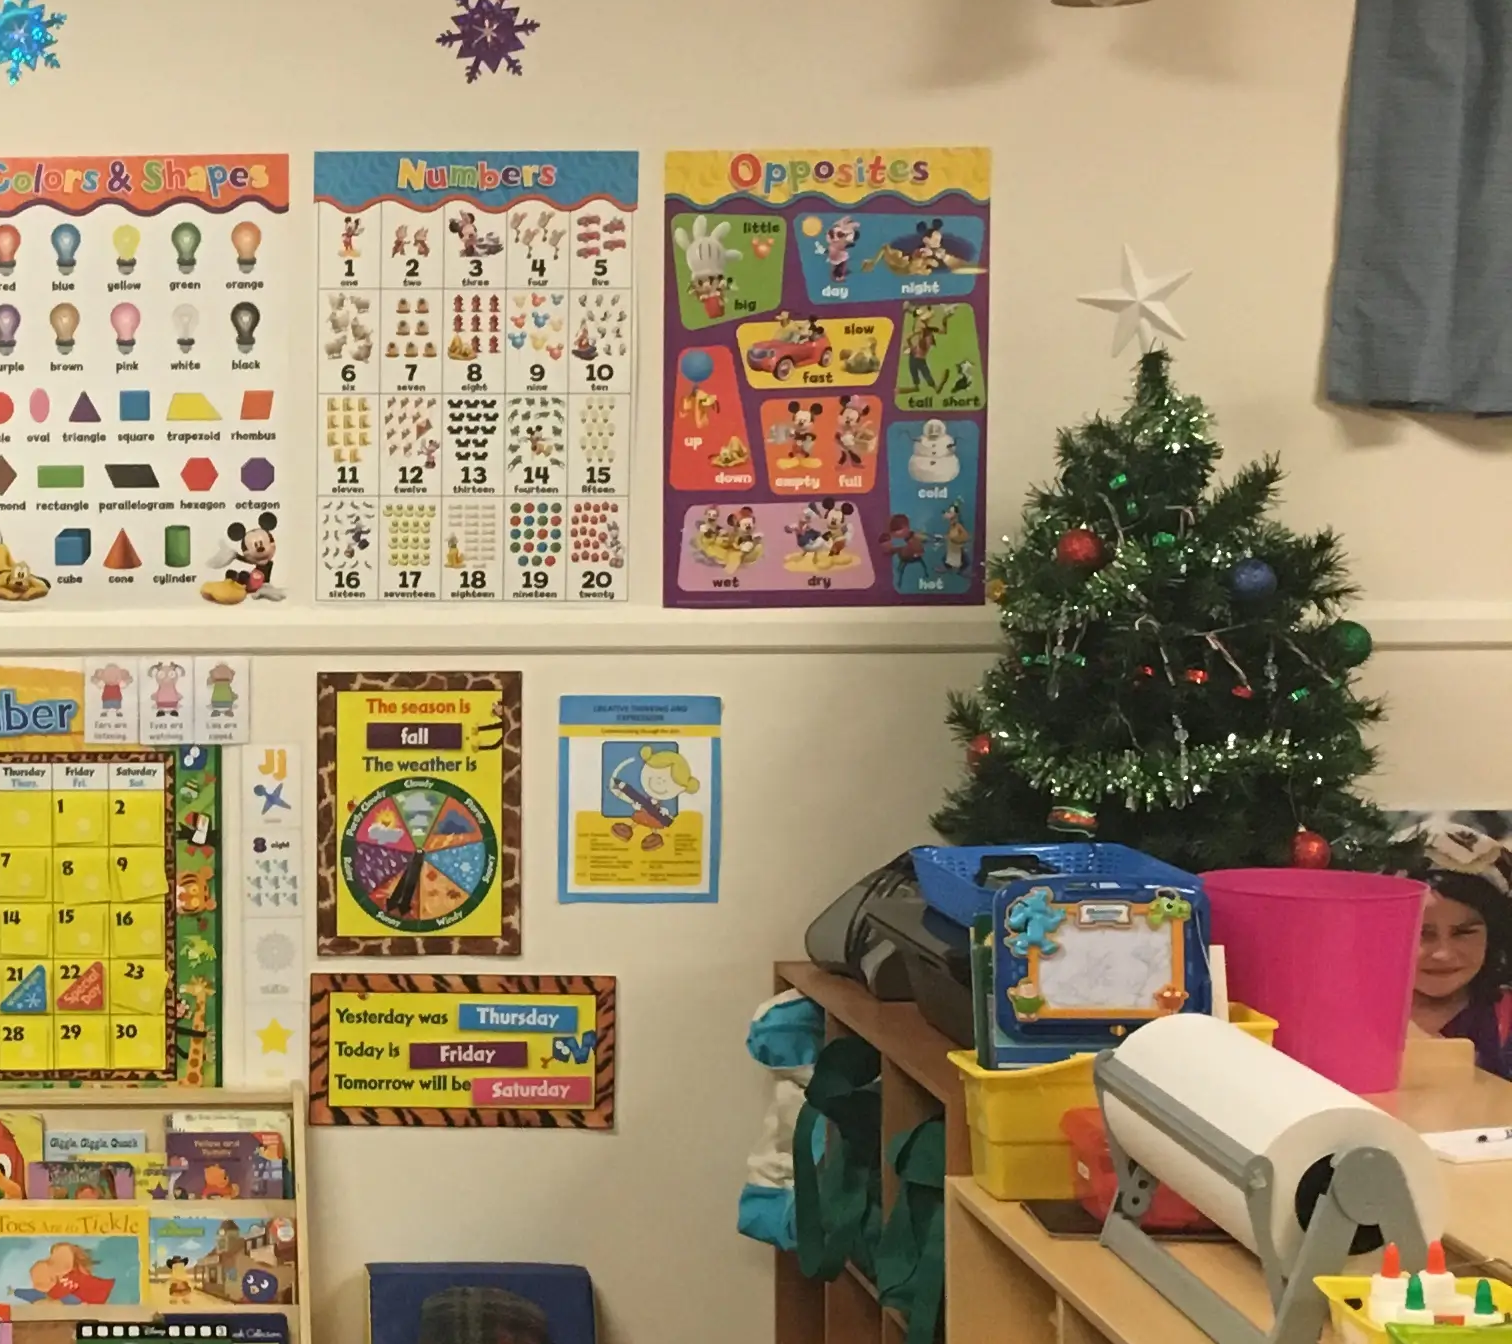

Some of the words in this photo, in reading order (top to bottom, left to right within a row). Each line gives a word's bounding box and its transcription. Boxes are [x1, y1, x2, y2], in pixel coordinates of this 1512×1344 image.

[107, 161, 132, 191] &
[142, 160, 269, 198] Shapes
[398, 159, 557, 190] Numbers
[729, 153, 930, 193] Opposites
[743, 222, 780, 233] little
[344, 260, 355, 277] 1
[531, 260, 546, 277] 4
[52, 281, 75, 291] blue
[107, 281, 141, 292] yellow
[169, 281, 201, 292] green
[822, 286, 848, 298] day
[902, 282, 939, 295] night
[734, 299, 756, 311] big
[844, 324, 874, 334] slow
[232, 359, 260, 370] black
[586, 365, 614, 381] 10
[803, 372, 833, 383] fast
[909, 396, 933, 408] tall
[943, 395, 980, 406] short
[62, 433, 106, 444] triangle
[118, 433, 154, 443] square
[684, 436, 702, 449] up
[587, 467, 611, 484] 15
[715, 473, 752, 484] down
[839, 475, 862, 487] full
[776, 476, 820, 488] empty
[919, 487, 948, 498] cold
[99, 500, 174, 511] parallelogram
[153, 573, 196, 585] cylinder
[582, 572, 612, 588] 20
[713, 577, 739, 587] wet
[808, 575, 831, 588] dry
[919, 577, 943, 589] hot
[367, 700, 397, 714] The
[401, 702, 455, 714] season
[460, 698, 470, 714] is
[401, 727, 428, 744] fall
[362, 758, 393, 771] The
[397, 756, 462, 771] weather
[466, 757, 477, 771] is
[3, 768, 45, 777] Thursday
[65, 767, 94, 777] Friday
[116, 767, 157, 776] Saturday
[404, 780, 433, 789] Cloudy
[57, 800, 63, 813] 1
[63, 861, 73, 875] 8
[436, 912, 463, 926] Windy
[336, 1009, 414, 1026] Yesterday
[419, 1012, 448, 1024] was
[477, 1008, 559, 1027] Thursday
[336, 1042, 384, 1059] Today
[389, 1043, 399, 1057] is
[440, 1046, 495, 1063] Friday
[335, 1075, 413, 1092] Tomorrow
[418, 1075, 447, 1091] will
[452, 1076, 471, 1091] be
[492, 1082, 570, 1098] Saturday
[111, 1137, 138, 1148] Quack
[41, 1222, 62, 1233] Are
[81, 1214, 138, 1234] Tickle
